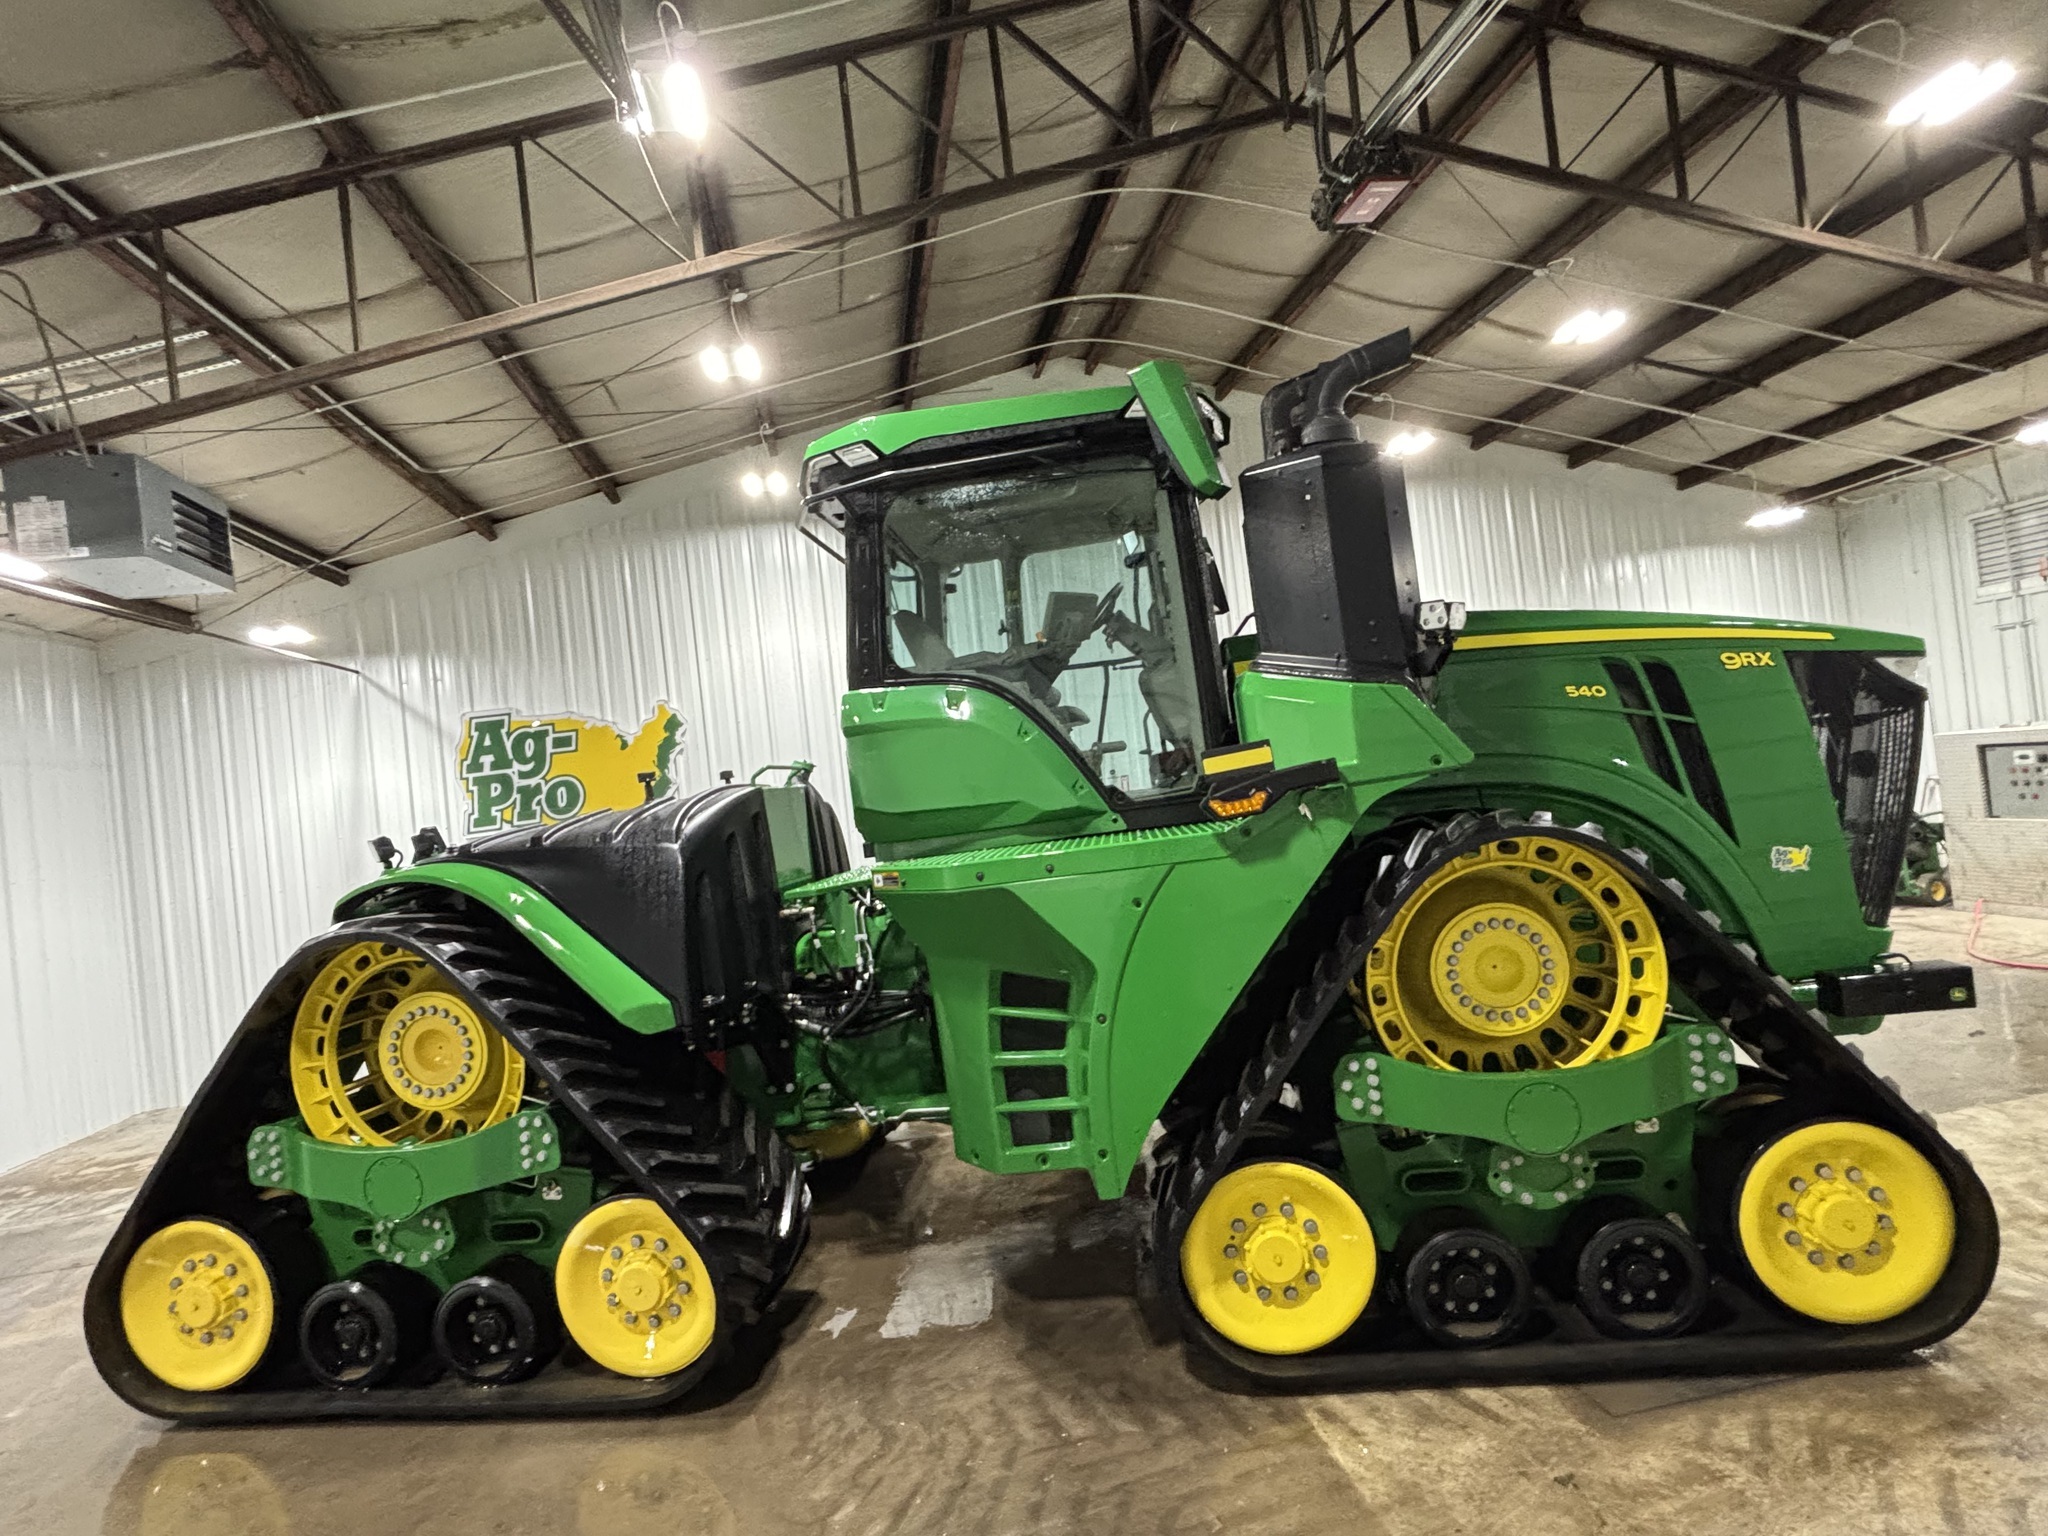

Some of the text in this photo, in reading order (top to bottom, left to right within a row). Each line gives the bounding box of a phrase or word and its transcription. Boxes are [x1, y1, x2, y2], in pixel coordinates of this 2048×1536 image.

[1720, 651, 1776, 670] 9RX
[1564, 685, 1607, 698] 540
[463, 714, 577, 780] Ag-
[470, 772, 585, 832] Pro
